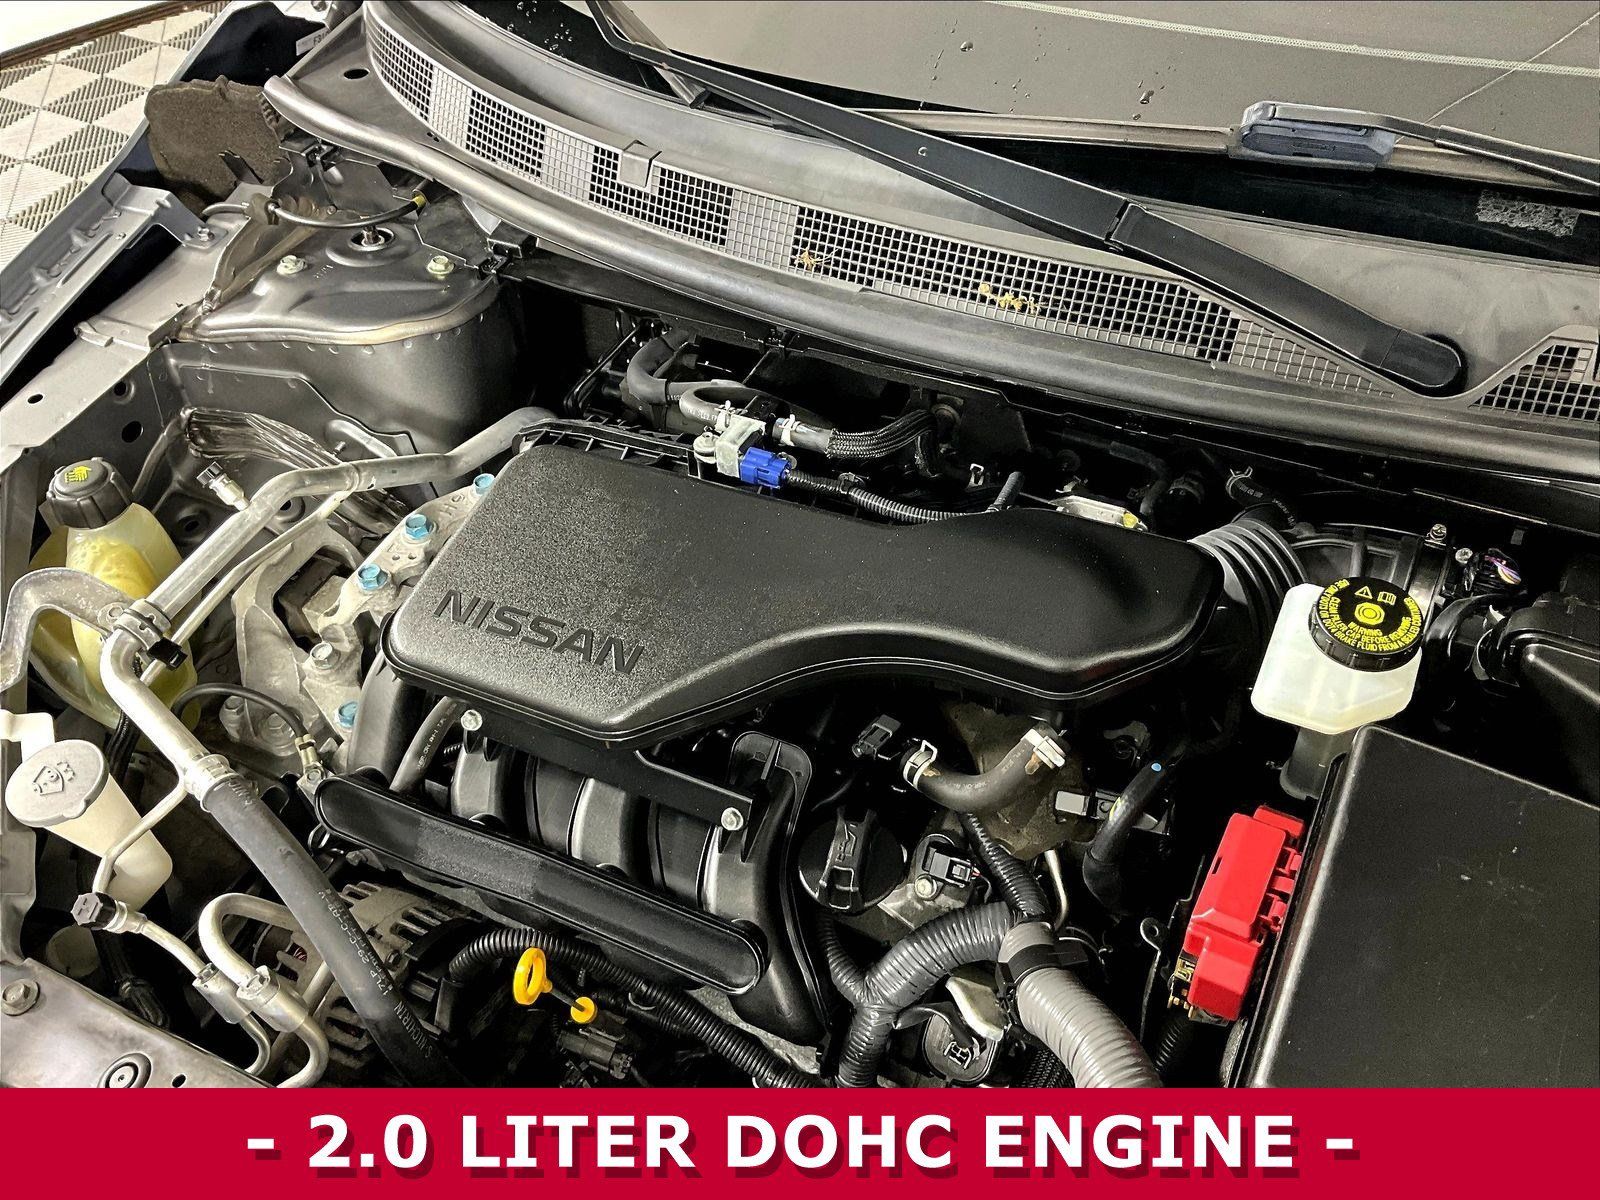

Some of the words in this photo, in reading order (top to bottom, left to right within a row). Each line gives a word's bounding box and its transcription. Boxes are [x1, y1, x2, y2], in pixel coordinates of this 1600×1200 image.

[1323, 584, 1338, 598] ONLY
[1329, 596, 1341, 614] CLEAN
[1403, 597, 1421, 626] CONTAINER
[1319, 610, 1330, 618] OR
[1323, 619, 1338, 633] DOT4
[1330, 614, 1348, 632] FILLER
[1348, 621, 1383, 637] WARNING
[1388, 616, 1411, 641] REMOVING
[433, 588, 645, 675] NISSAN
[1334, 631, 1358, 647] BRAKE
[1345, 629, 1361, 639] CAP
[1361, 635, 1391, 643] BEFORE
[1401, 626, 1420, 644] SEALED
[1357, 642, 1378, 651] FLUID
[1378, 642, 1399, 651] FROM
